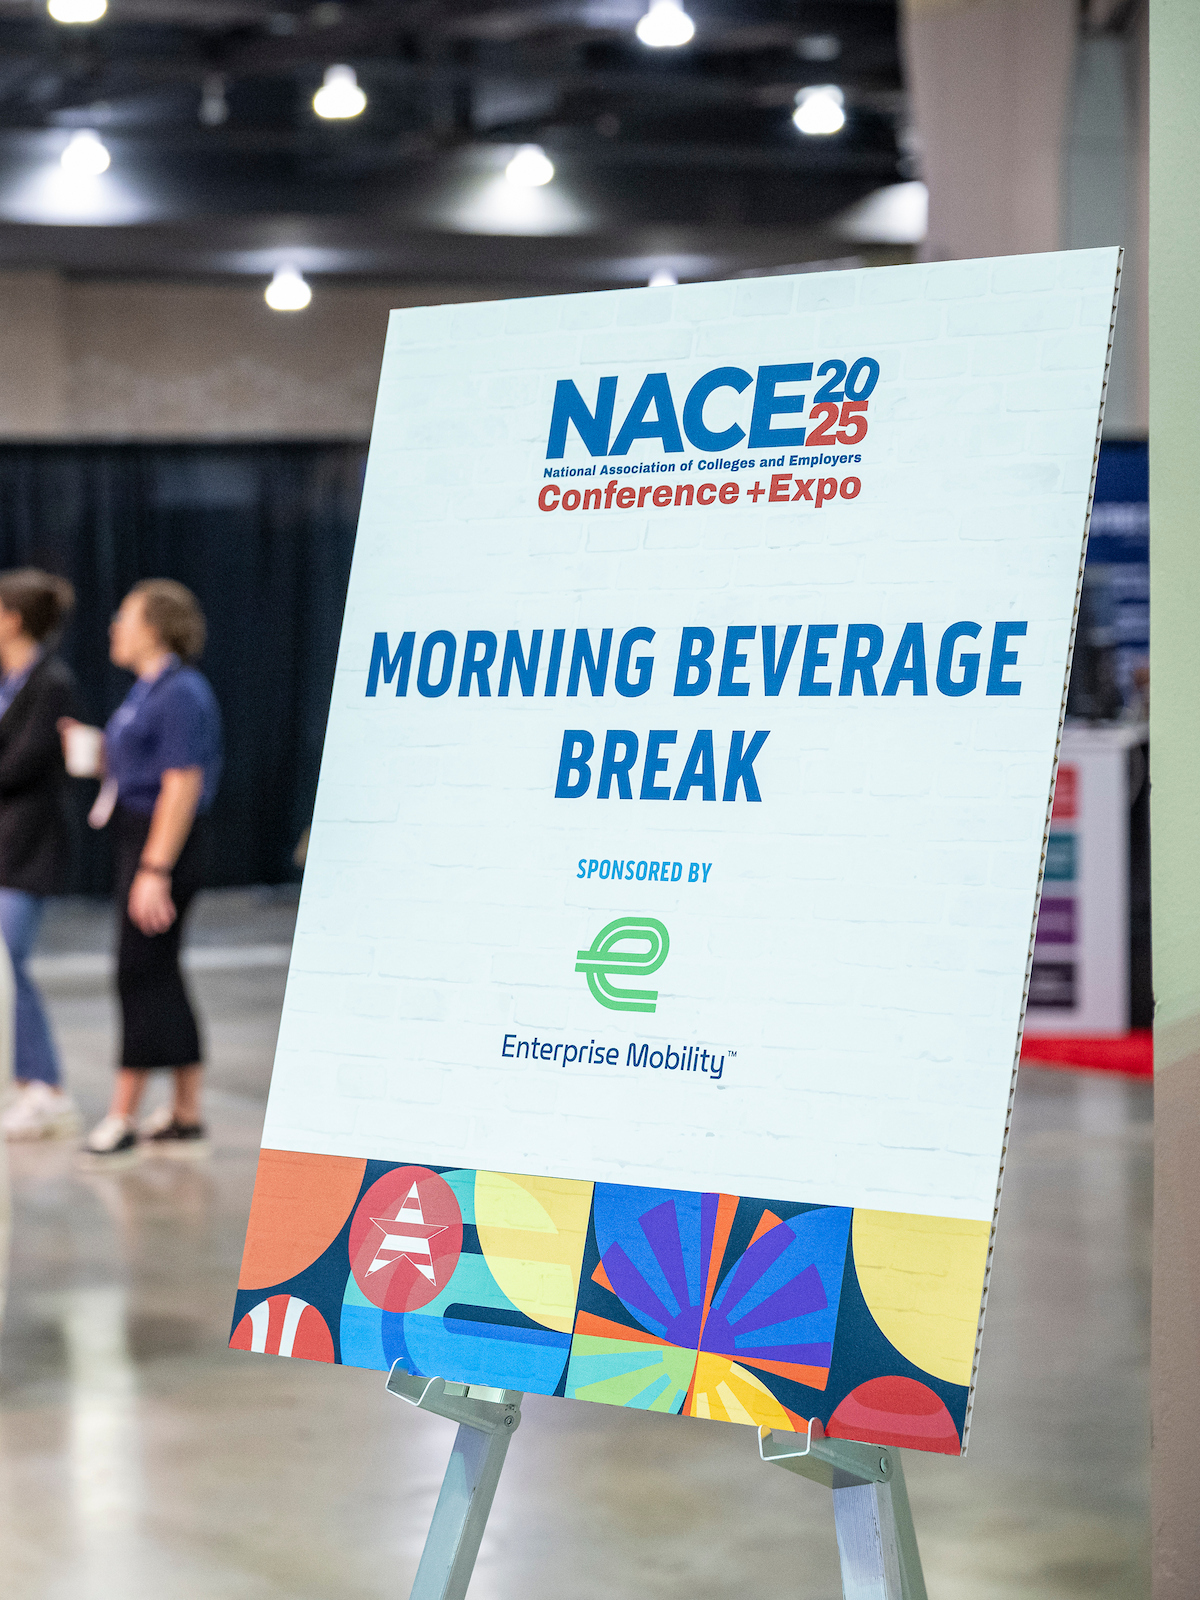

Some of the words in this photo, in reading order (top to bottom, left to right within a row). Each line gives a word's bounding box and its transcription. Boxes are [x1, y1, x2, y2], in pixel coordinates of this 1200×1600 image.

[545, 362, 814, 460] NACE
[813, 356, 881, 404] 20
[804, 400, 869, 447] 25
[543, 465, 597, 478] National
[599, 460, 676, 476] Association
[679, 458, 694, 472] of
[697, 456, 755, 473] Colleges
[759, 455, 785, 469] and
[788, 452, 862, 469] Employers
[538, 480, 740, 512] Conference
[364, 626, 657, 698] MORNING
[672, 620, 1029, 697] BEVERAGE
[554, 729, 771, 802] BREAK
[576, 858, 683, 882] SPONSORED
[687, 861, 713, 884] BY
[501, 1033, 620, 1068] Enterprise
